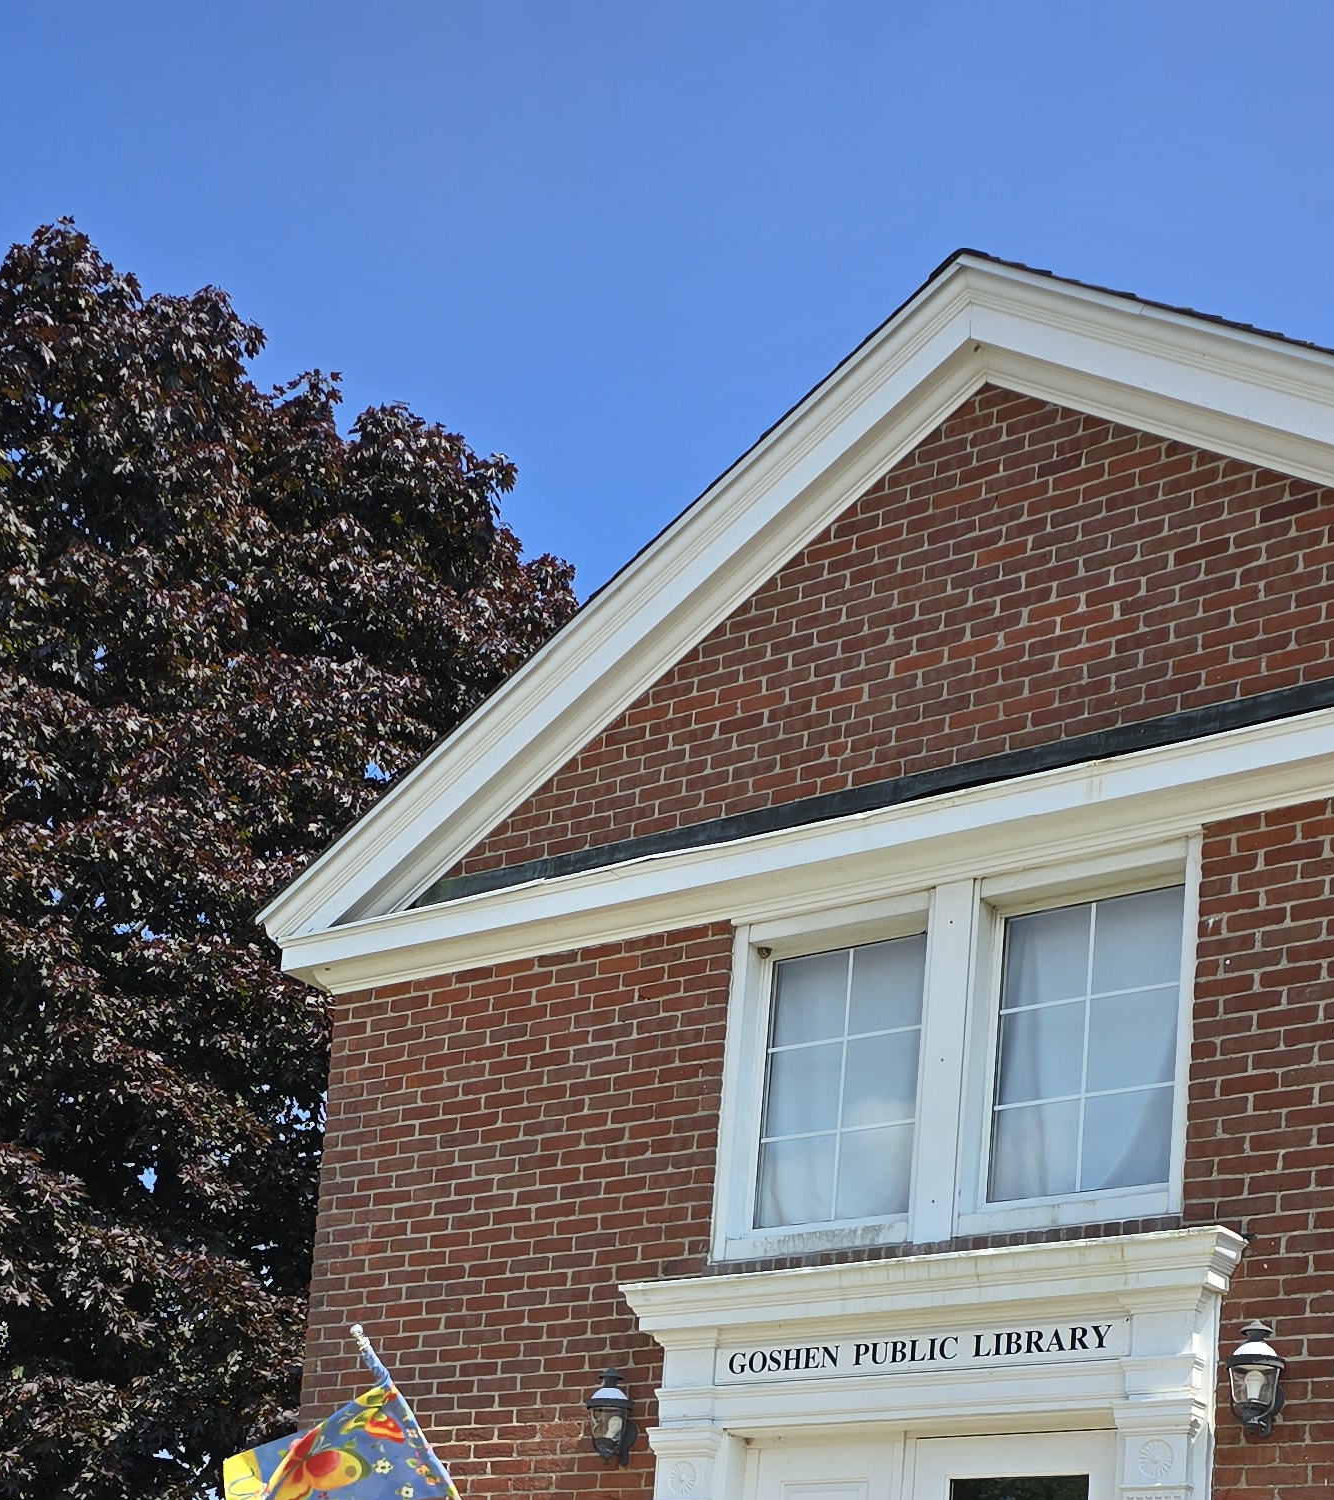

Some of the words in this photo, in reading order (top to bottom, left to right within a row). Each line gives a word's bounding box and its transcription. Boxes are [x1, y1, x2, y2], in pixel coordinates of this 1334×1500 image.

[728, 1345, 840, 1375] GOSHEN
[852, 1336, 959, 1367] PUBLIC
[971, 1323, 1114, 1358] LIBRARY
